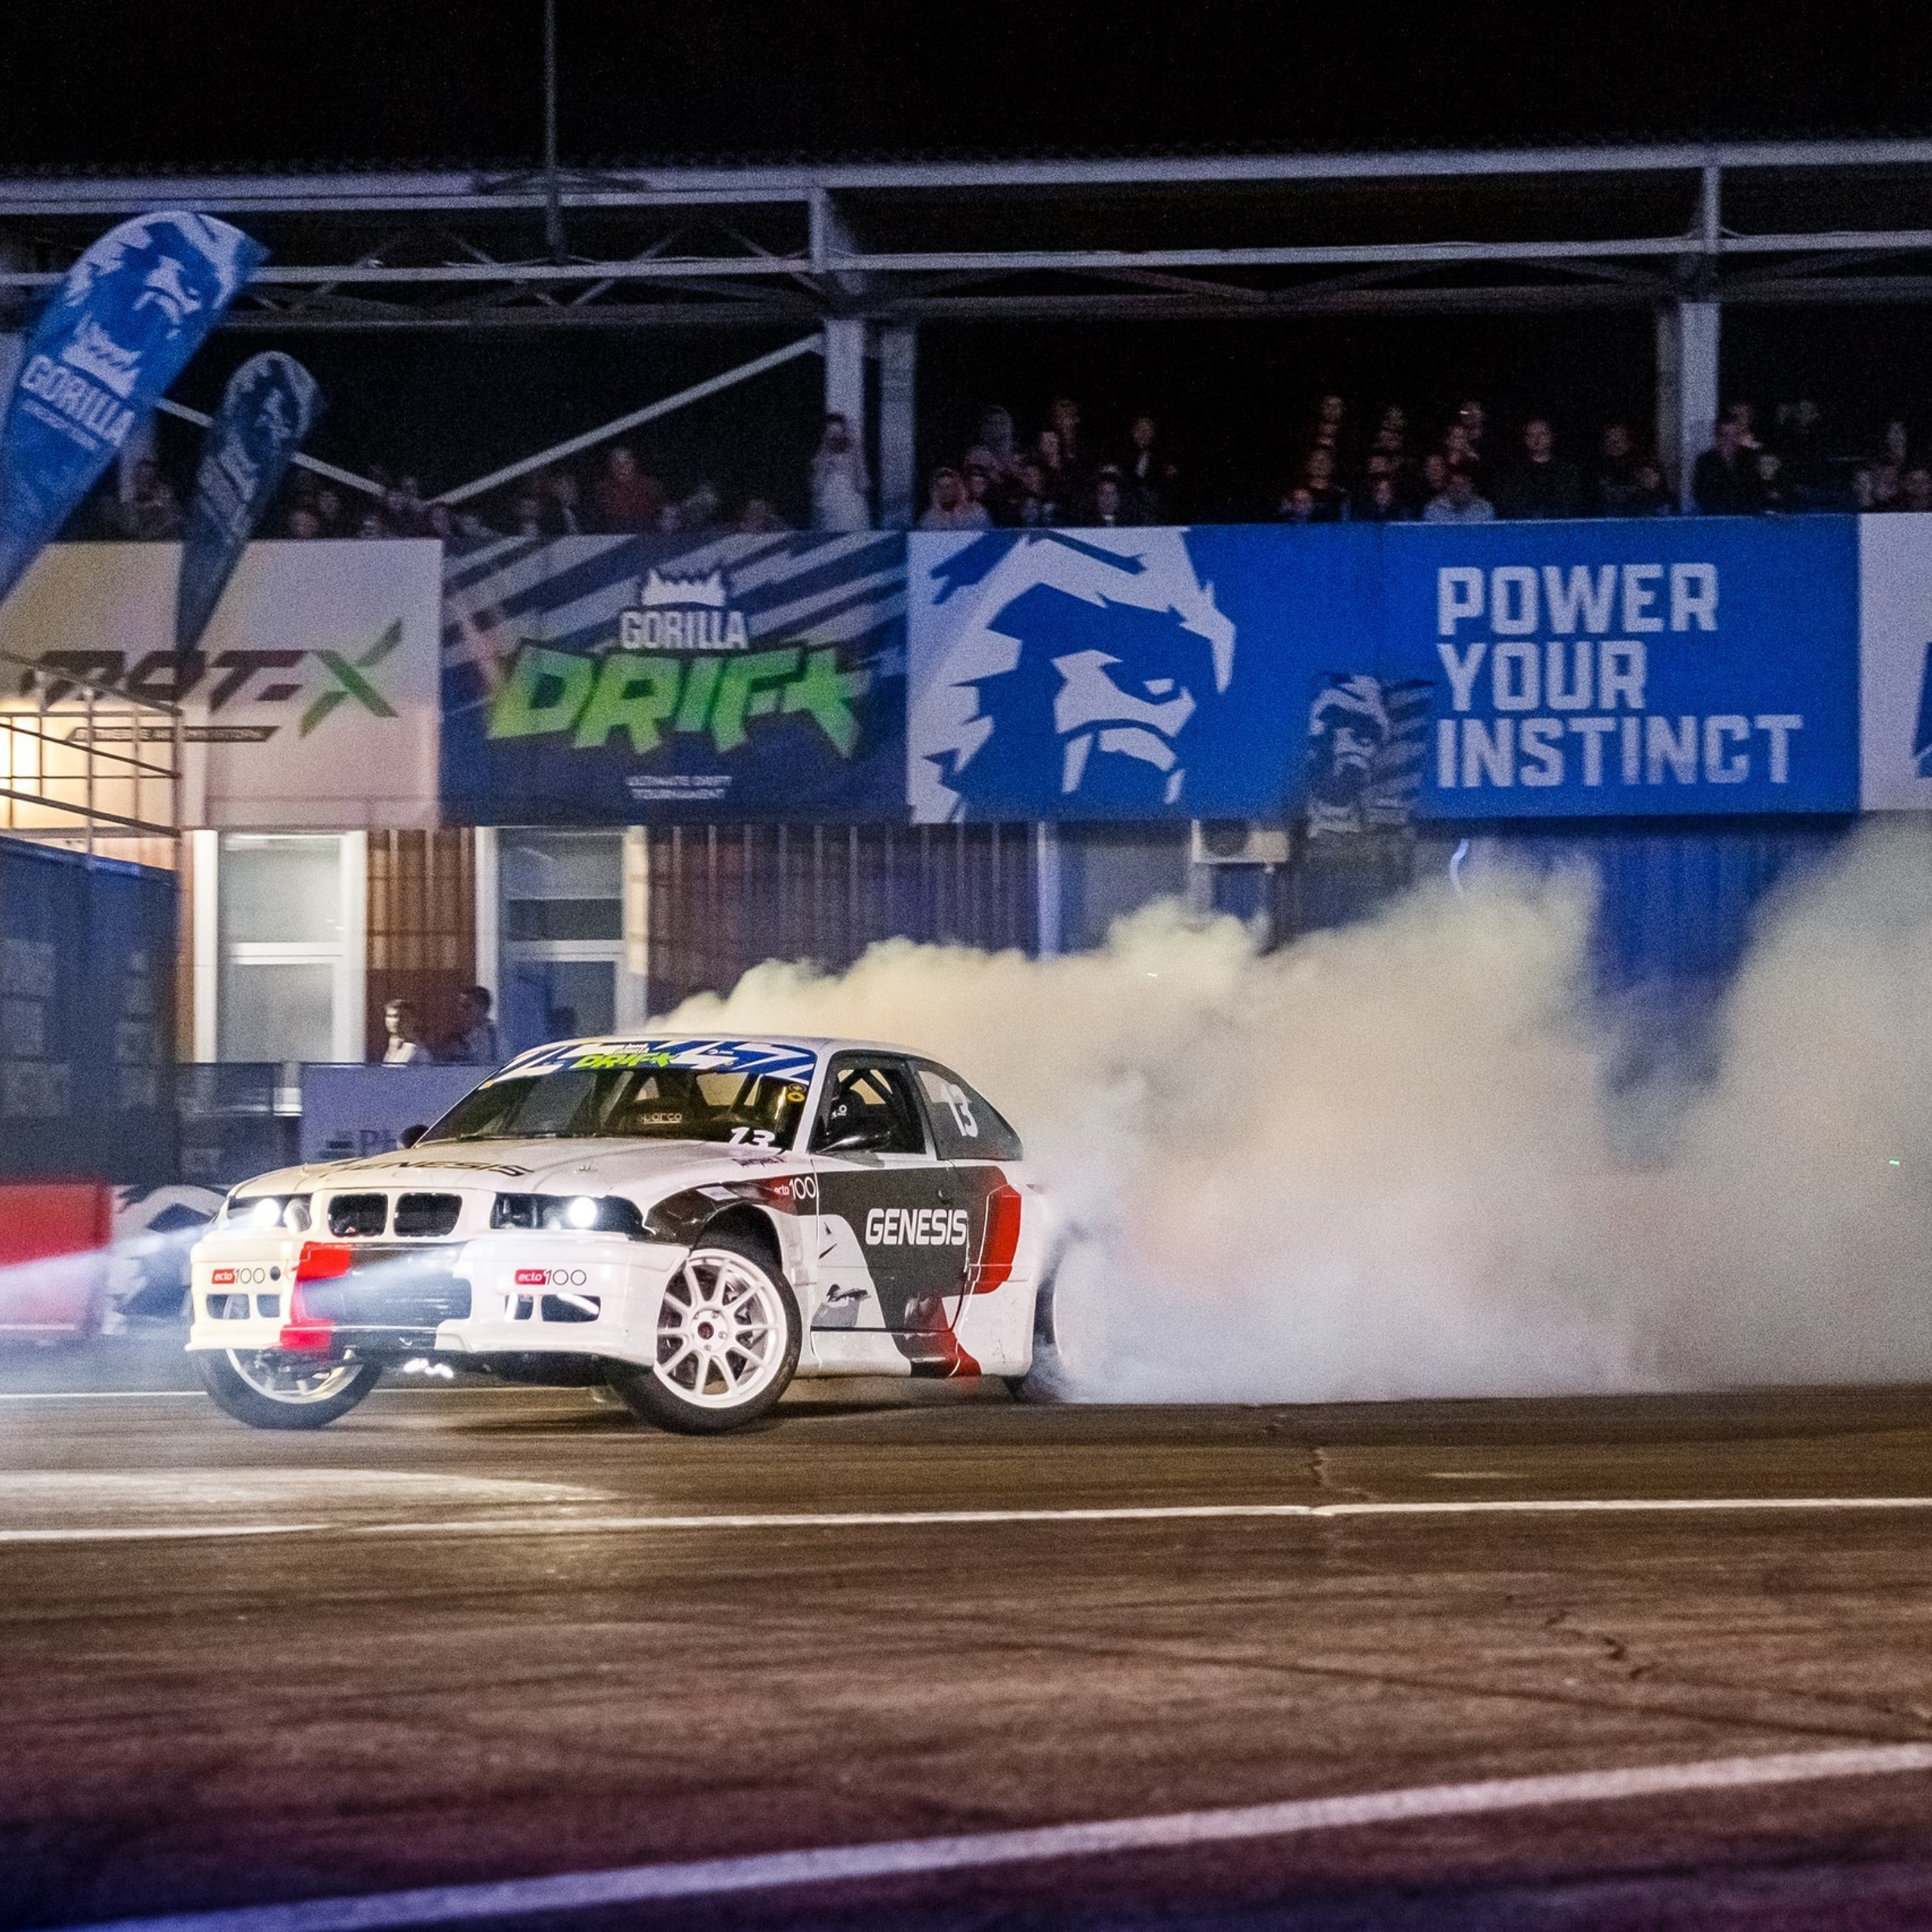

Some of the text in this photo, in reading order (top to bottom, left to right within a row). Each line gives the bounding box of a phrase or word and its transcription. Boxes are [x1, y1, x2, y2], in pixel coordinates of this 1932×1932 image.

[20, 354, 134, 448] GORILLA
[620, 610, 749, 650] GORILLA
[1438, 563, 1719, 635] POWER
[487, 645, 871, 757] DRIFT
[1437, 640, 1647, 712] YOUR
[1438, 714, 1804, 789] INSTINCT
[572, 1052, 676, 1068] DRIFT
[729, 1126, 777, 1147] 13
[940, 1082, 979, 1138] 13
[865, 1208, 968, 1245] GENESIS
